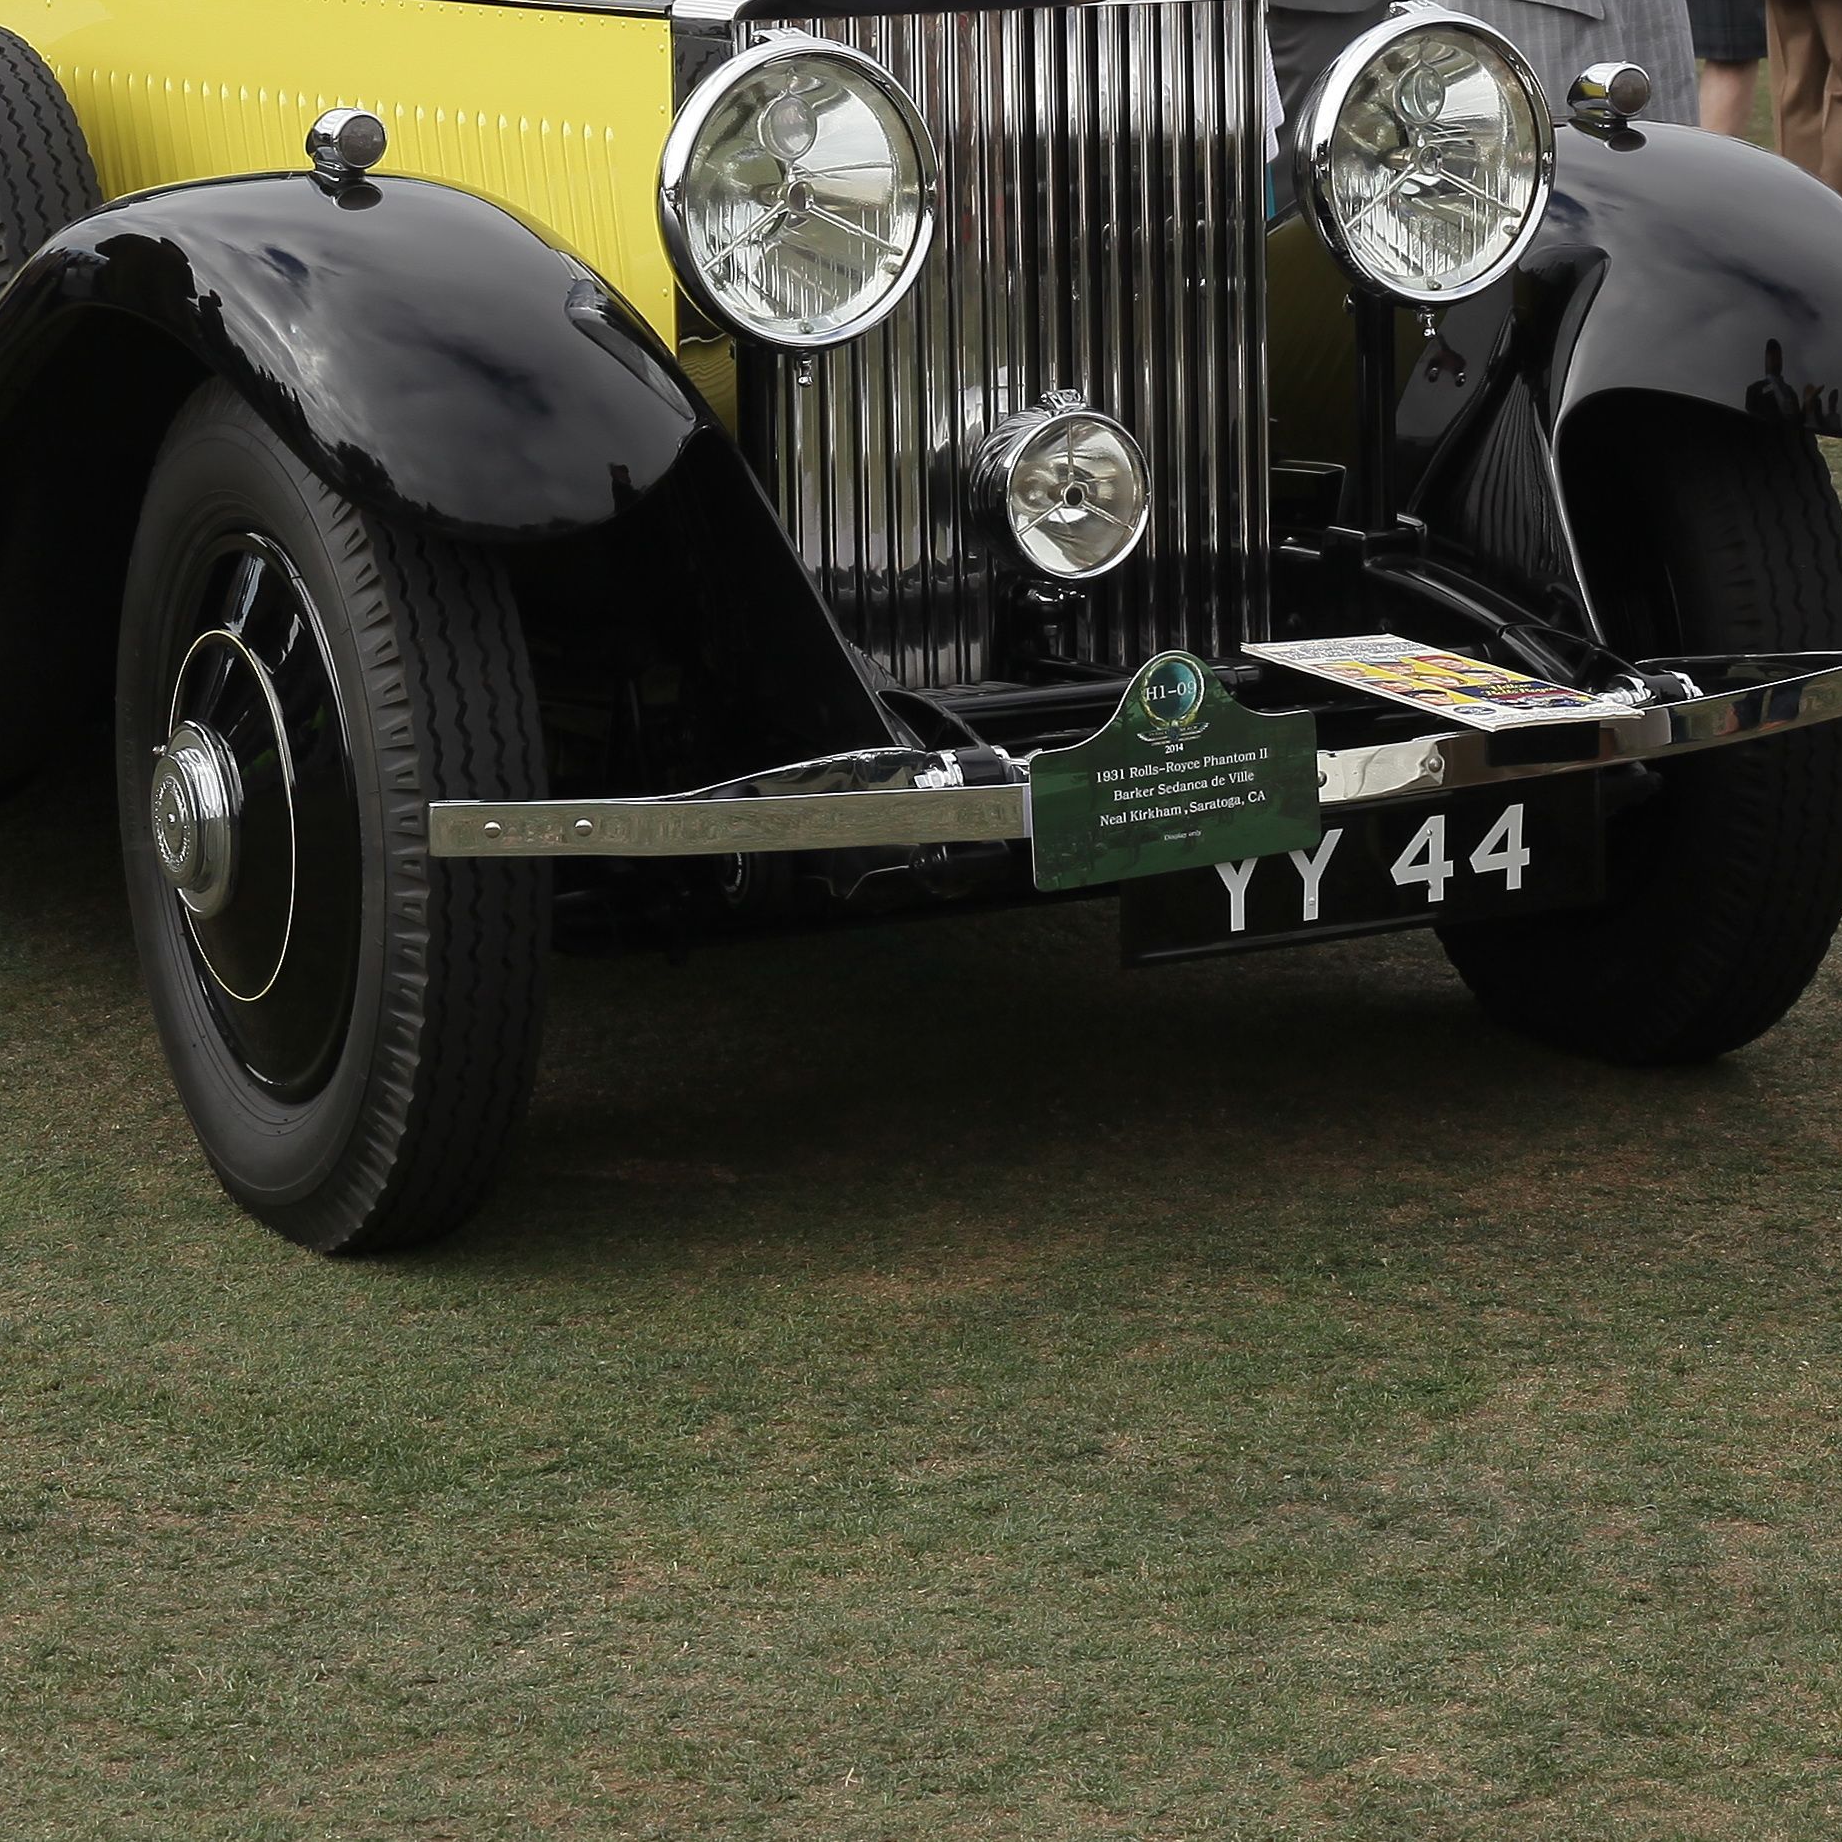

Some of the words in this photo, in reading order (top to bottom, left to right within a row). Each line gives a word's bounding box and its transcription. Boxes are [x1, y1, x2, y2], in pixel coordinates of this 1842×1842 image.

[1146, 681, 1196, 701] H1-09
[1165, 742, 1184, 755] 2014
[1096, 769, 1125, 783] 1931
[1129, 759, 1200, 779] Rolls-Royce
[1203, 752, 1256, 768] Phantom
[1259, 748, 1268, 759] II
[1113, 786, 1155, 802] Barker
[1158, 778, 1208, 796] Sedanca
[1211, 775, 1226, 787] de
[1228, 770, 1255, 784] Ville
[1100, 812, 1127, 827] Neal
[1130, 804, 1182, 823] Kirkham
[1248, 790, 1266, 803] CA
[1214, 828, 1344, 932] YY
[1390, 803, 1531, 903] 44
